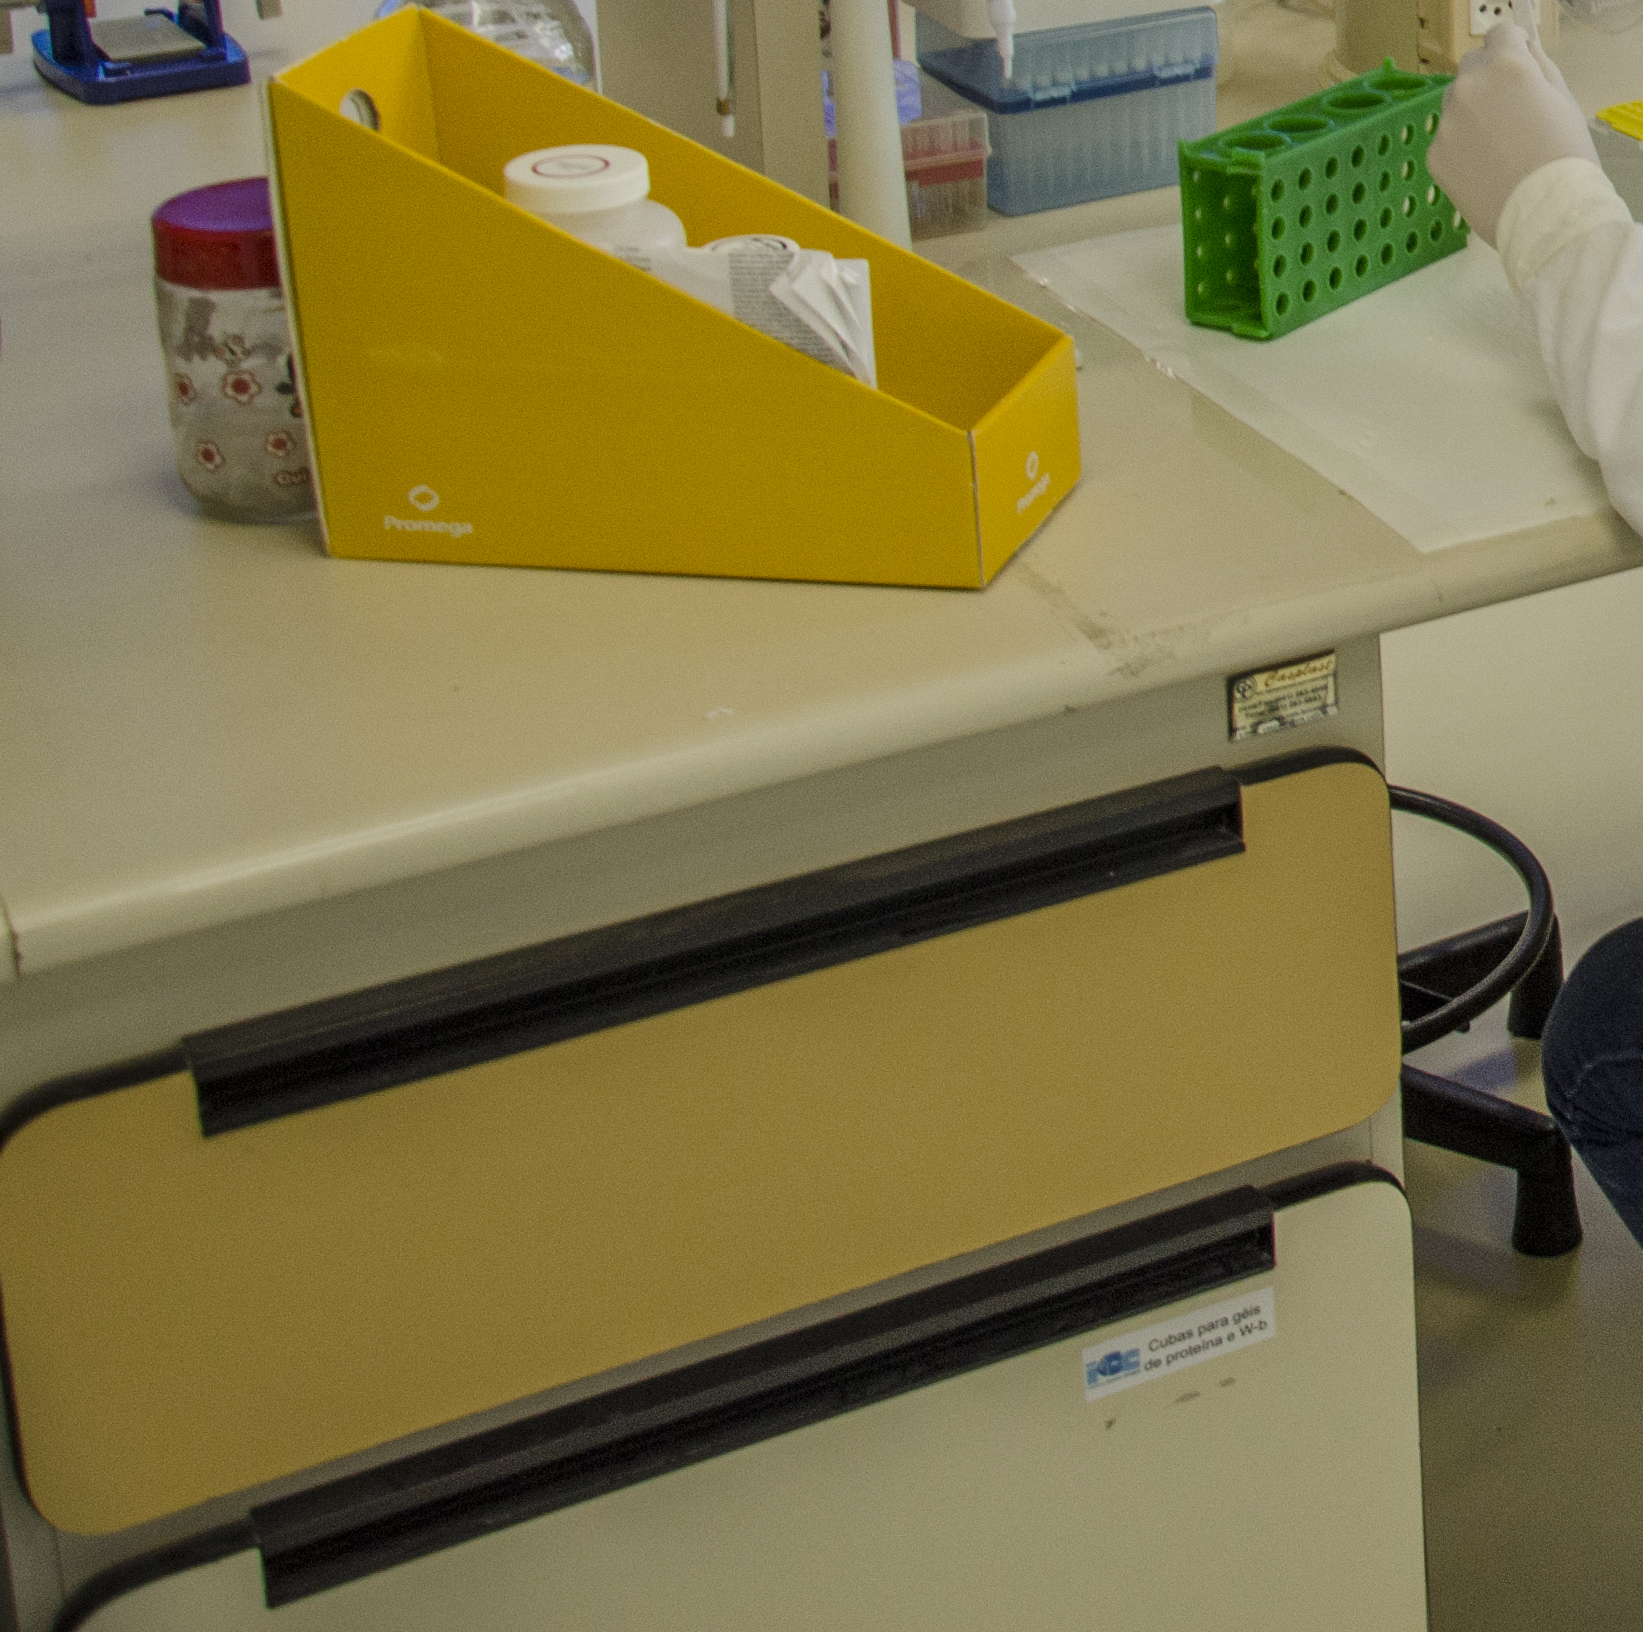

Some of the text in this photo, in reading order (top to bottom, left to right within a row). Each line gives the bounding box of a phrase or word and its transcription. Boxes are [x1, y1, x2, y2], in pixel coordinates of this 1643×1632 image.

[1015, 471, 1052, 516] Promega
[382, 514, 474, 539] Promega
[1148, 1303, 1262, 1353] Cubas para géis
[1143, 1357, 1163, 1372] de
[1226, 1331, 1236, 1342] e
